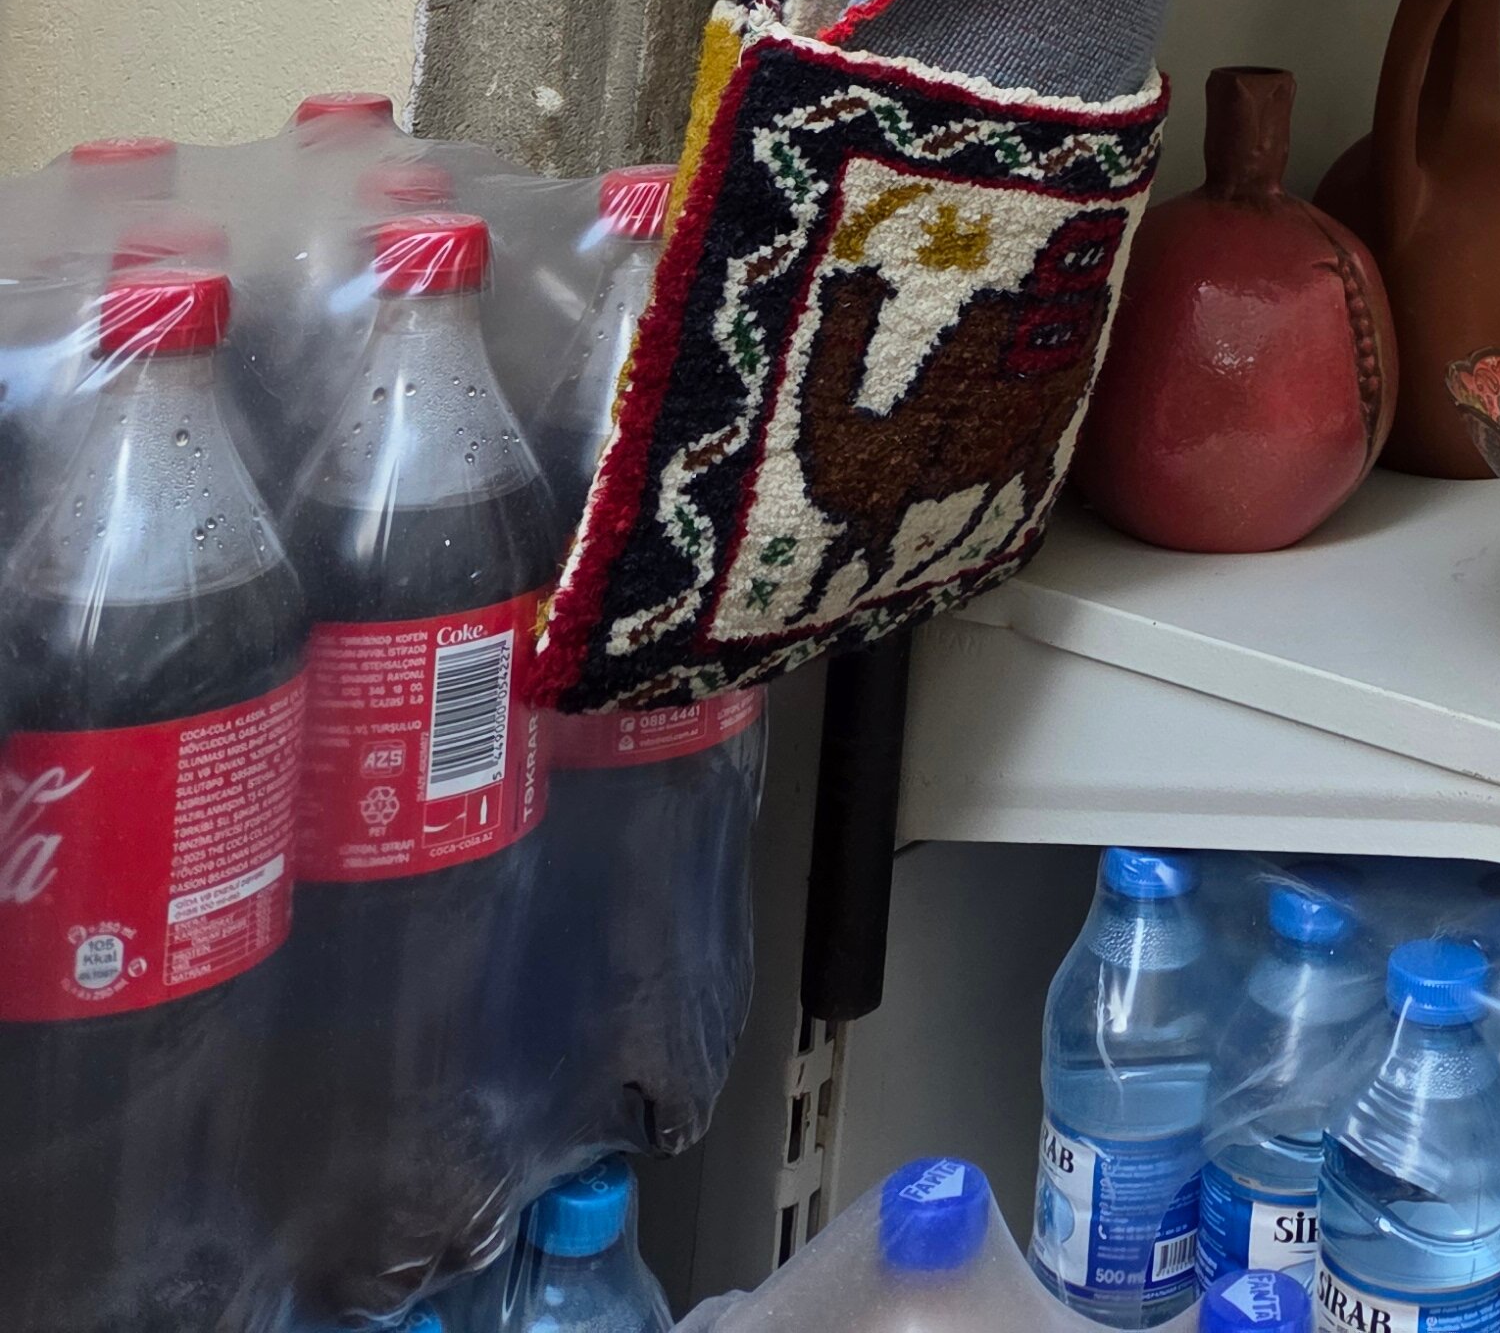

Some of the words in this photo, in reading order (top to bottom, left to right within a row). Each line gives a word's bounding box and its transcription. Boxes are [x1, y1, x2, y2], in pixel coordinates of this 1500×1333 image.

[437, 624, 484, 646] Coke
[640, 714, 667, 729] 088
[364, 749, 404, 769] AZS
[1095, 1268, 1126, 1285] 500
